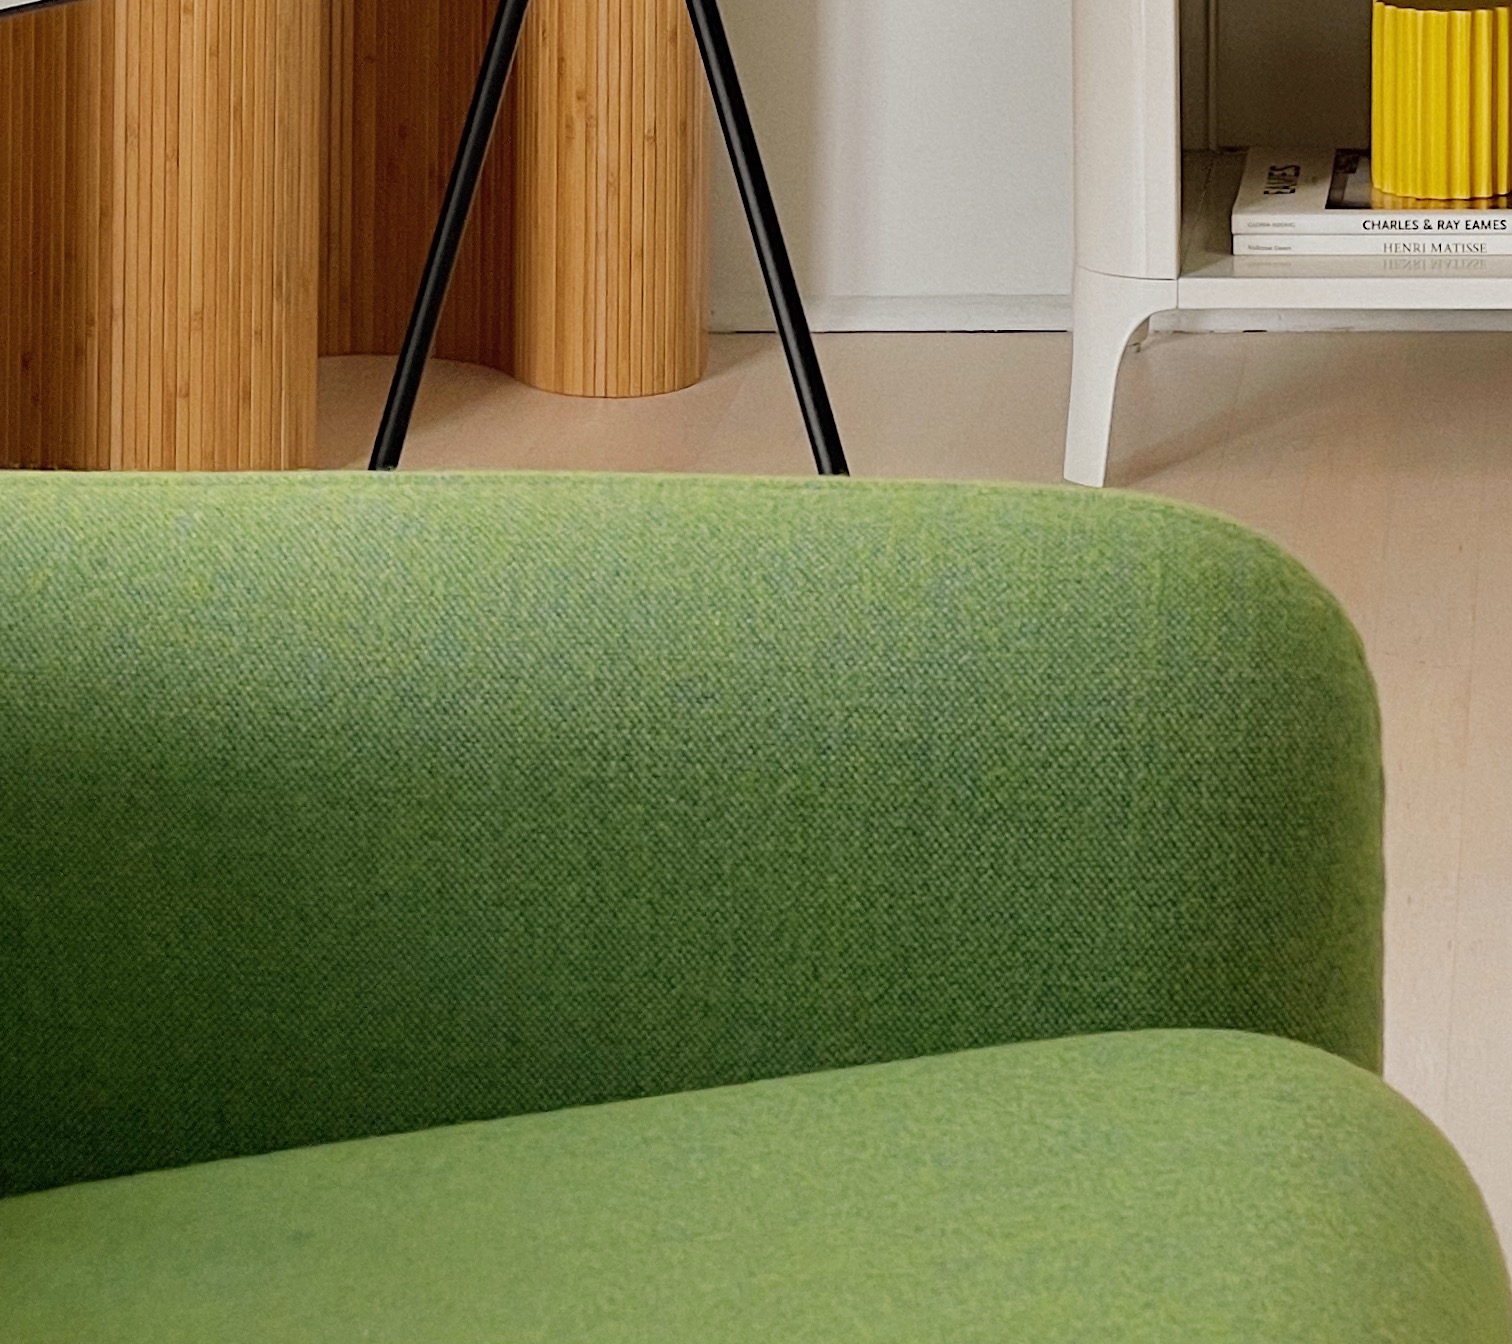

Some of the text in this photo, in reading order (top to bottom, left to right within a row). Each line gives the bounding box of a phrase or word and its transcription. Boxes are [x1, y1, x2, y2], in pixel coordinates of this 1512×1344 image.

[1362, 219, 1508, 231] CHARLES & RAY EAMES
[1383, 242, 1487, 254] HENRI MATISSE
